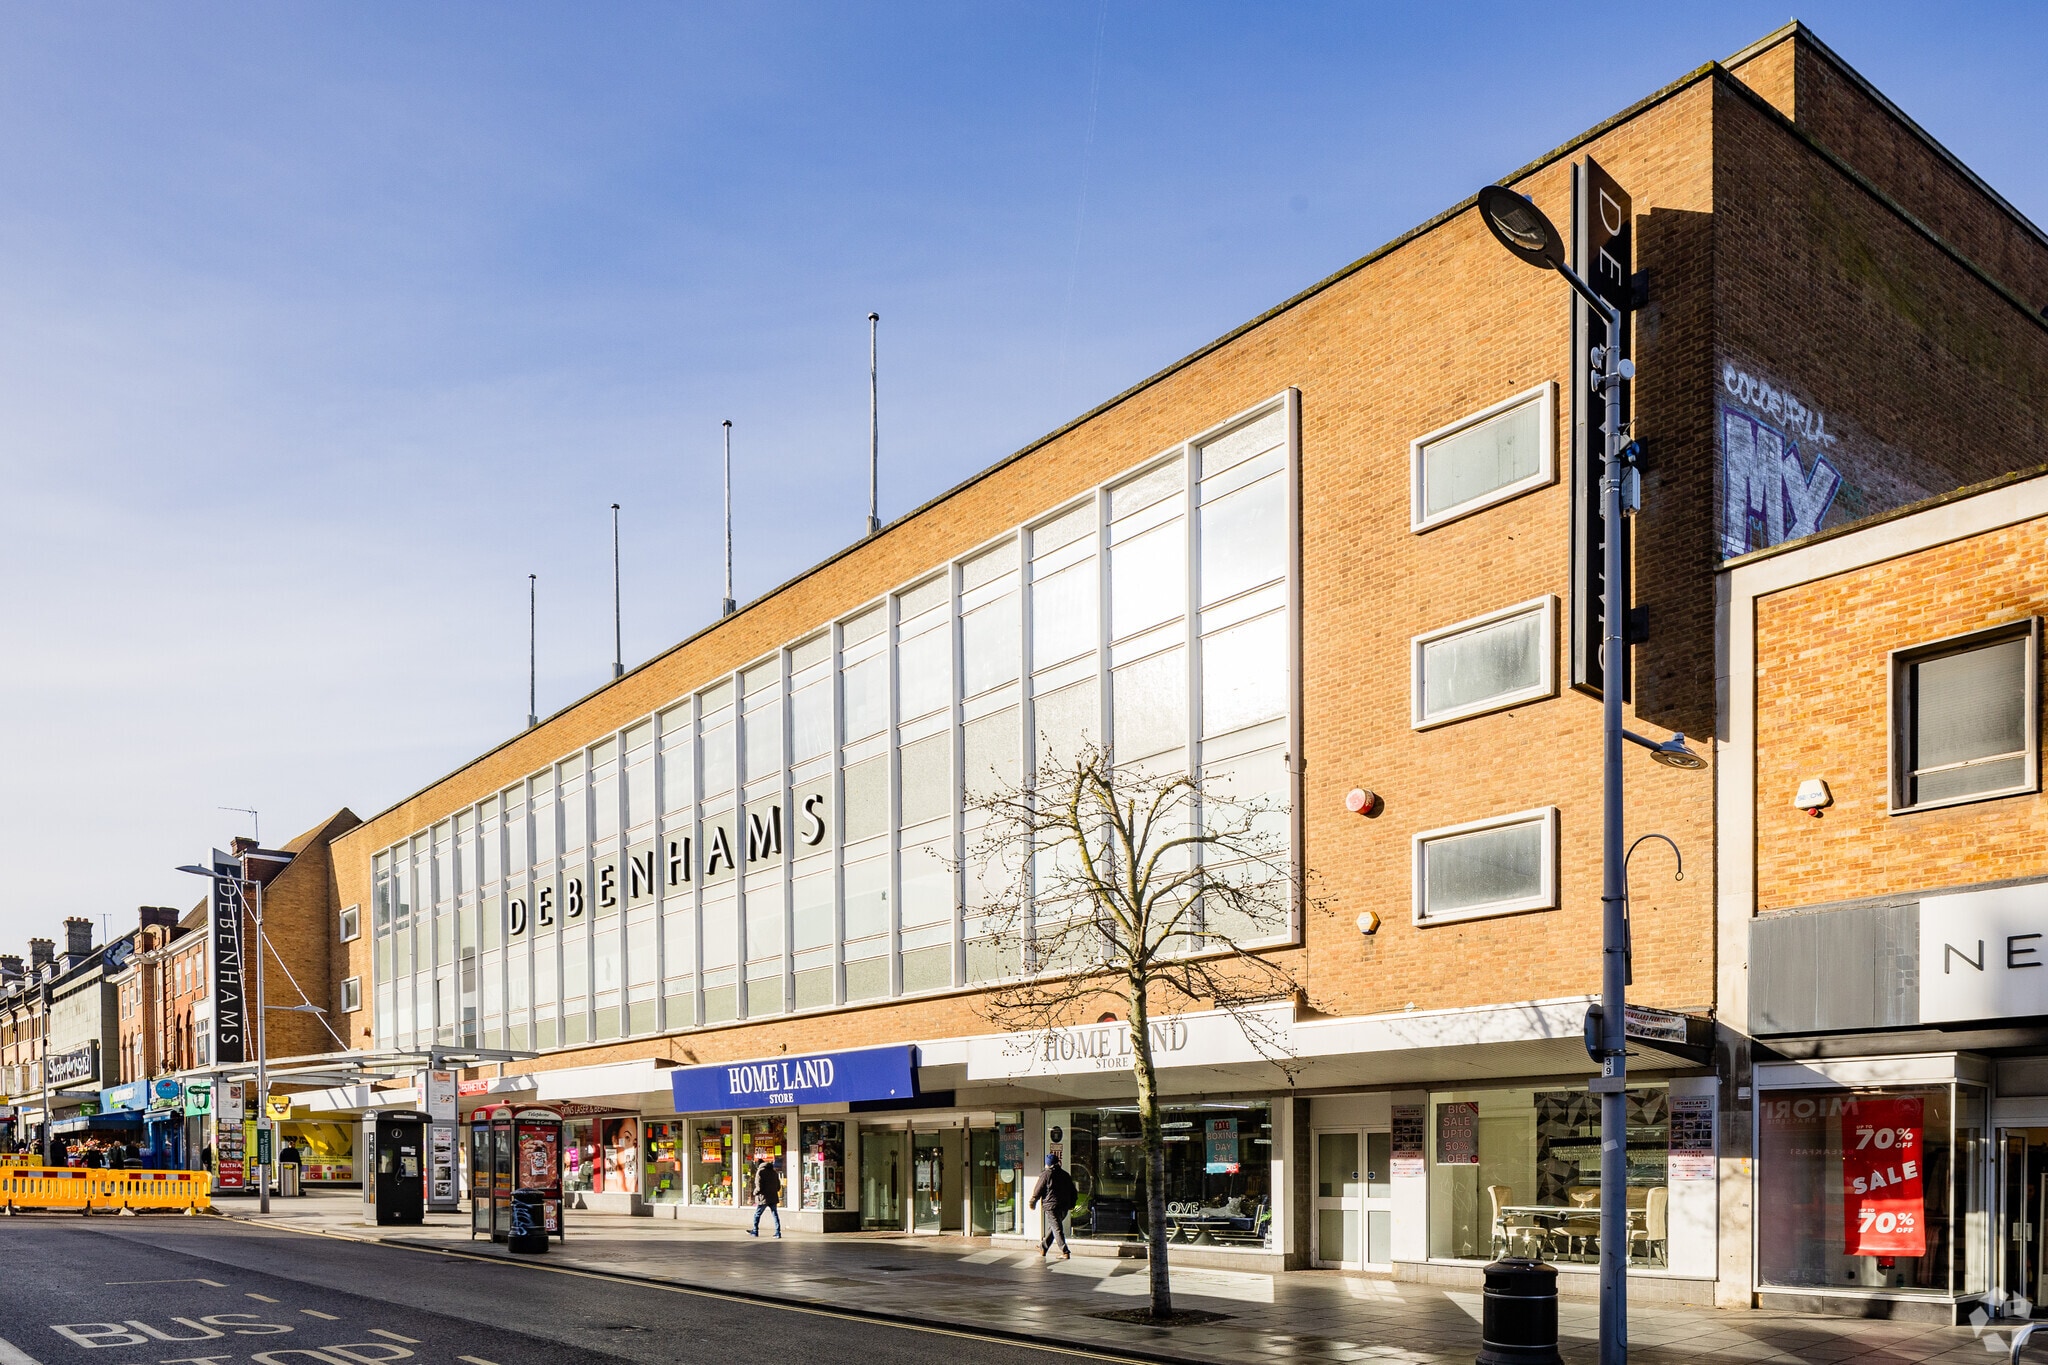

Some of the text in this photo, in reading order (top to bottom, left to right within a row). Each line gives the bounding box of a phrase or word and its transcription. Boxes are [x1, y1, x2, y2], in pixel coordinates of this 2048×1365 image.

[509, 794, 825, 935] DEBENHAMS
[218, 882, 239, 1044] DEBENHAMS
[1043, 1020, 1188, 1062] HOME LND
[1095, 1057, 1129, 1069] STORE
[727, 1058, 834, 1095] HOME LAND
[769, 1093, 794, 1104] STORE
[560, 1106, 574, 1114] SKINS
[575, 1105, 590, 1114] LASER
[1448, 1105, 1467, 1114] BIG
[1443, 1117, 1471, 1126] SALE
[1206, 1132, 1238, 1140] BOXING
[1855, 1128, 1914, 1150] 70%
[1215, 1143, 1231, 1151] DAY
[1445, 1142, 1469, 1151] 50%
[1213, 1154, 1233, 1162] SALE
[1447, 1154, 1468, 1163] OFF
[1853, 1160, 1918, 1194] SALE
[1167, 1201, 1199, 1214] OVE
[1857, 1212, 1915, 1234] 70%
[50, 1313, 295, 1348] BUS
